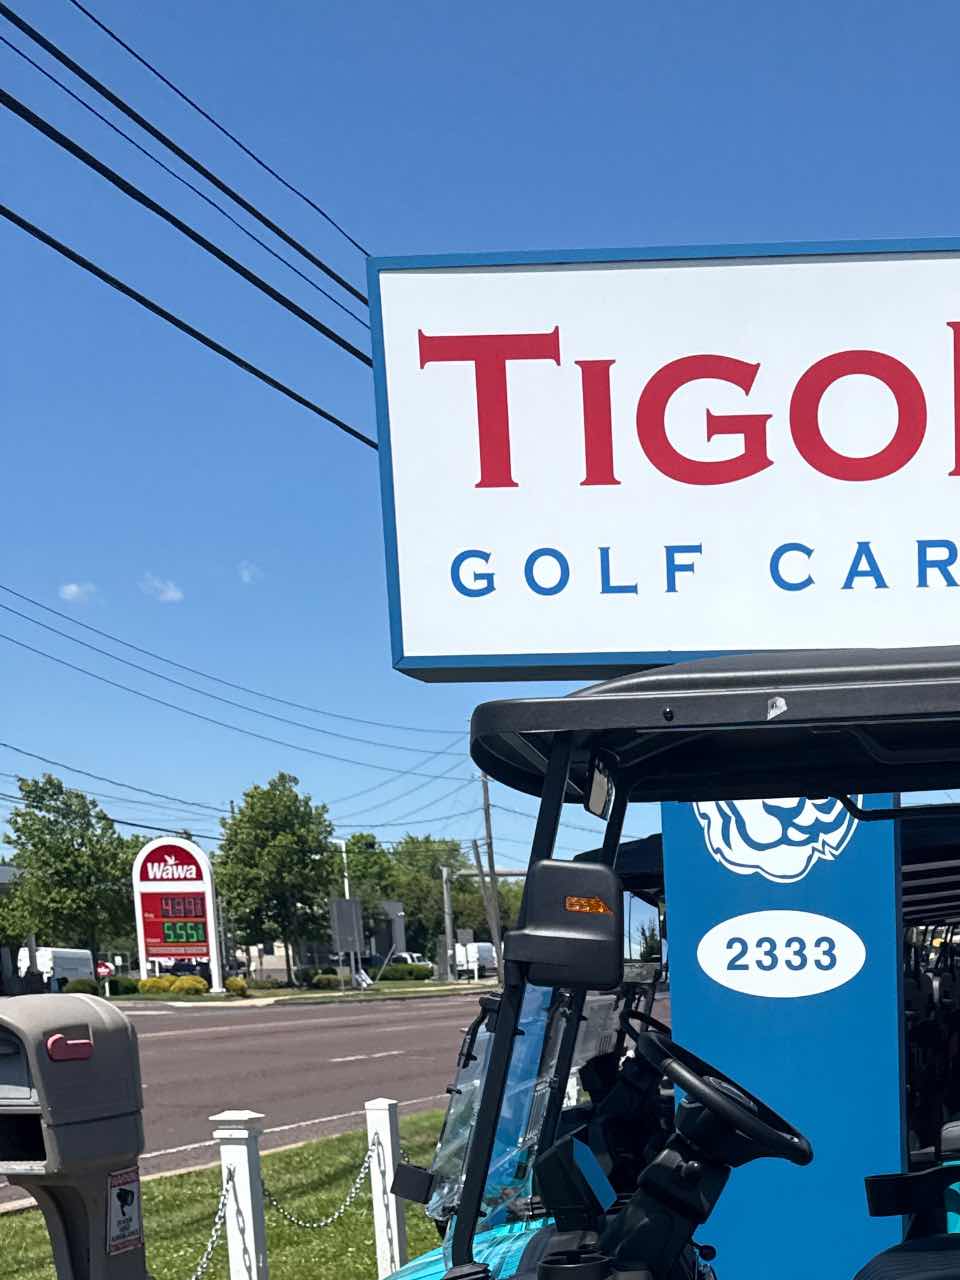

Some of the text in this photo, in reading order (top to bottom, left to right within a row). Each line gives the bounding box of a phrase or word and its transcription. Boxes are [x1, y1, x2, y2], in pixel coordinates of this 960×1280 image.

[450, 544, 702, 597] GOLF
[147, 861, 197, 880] Wawa
[726, 936, 837, 971] 2333
